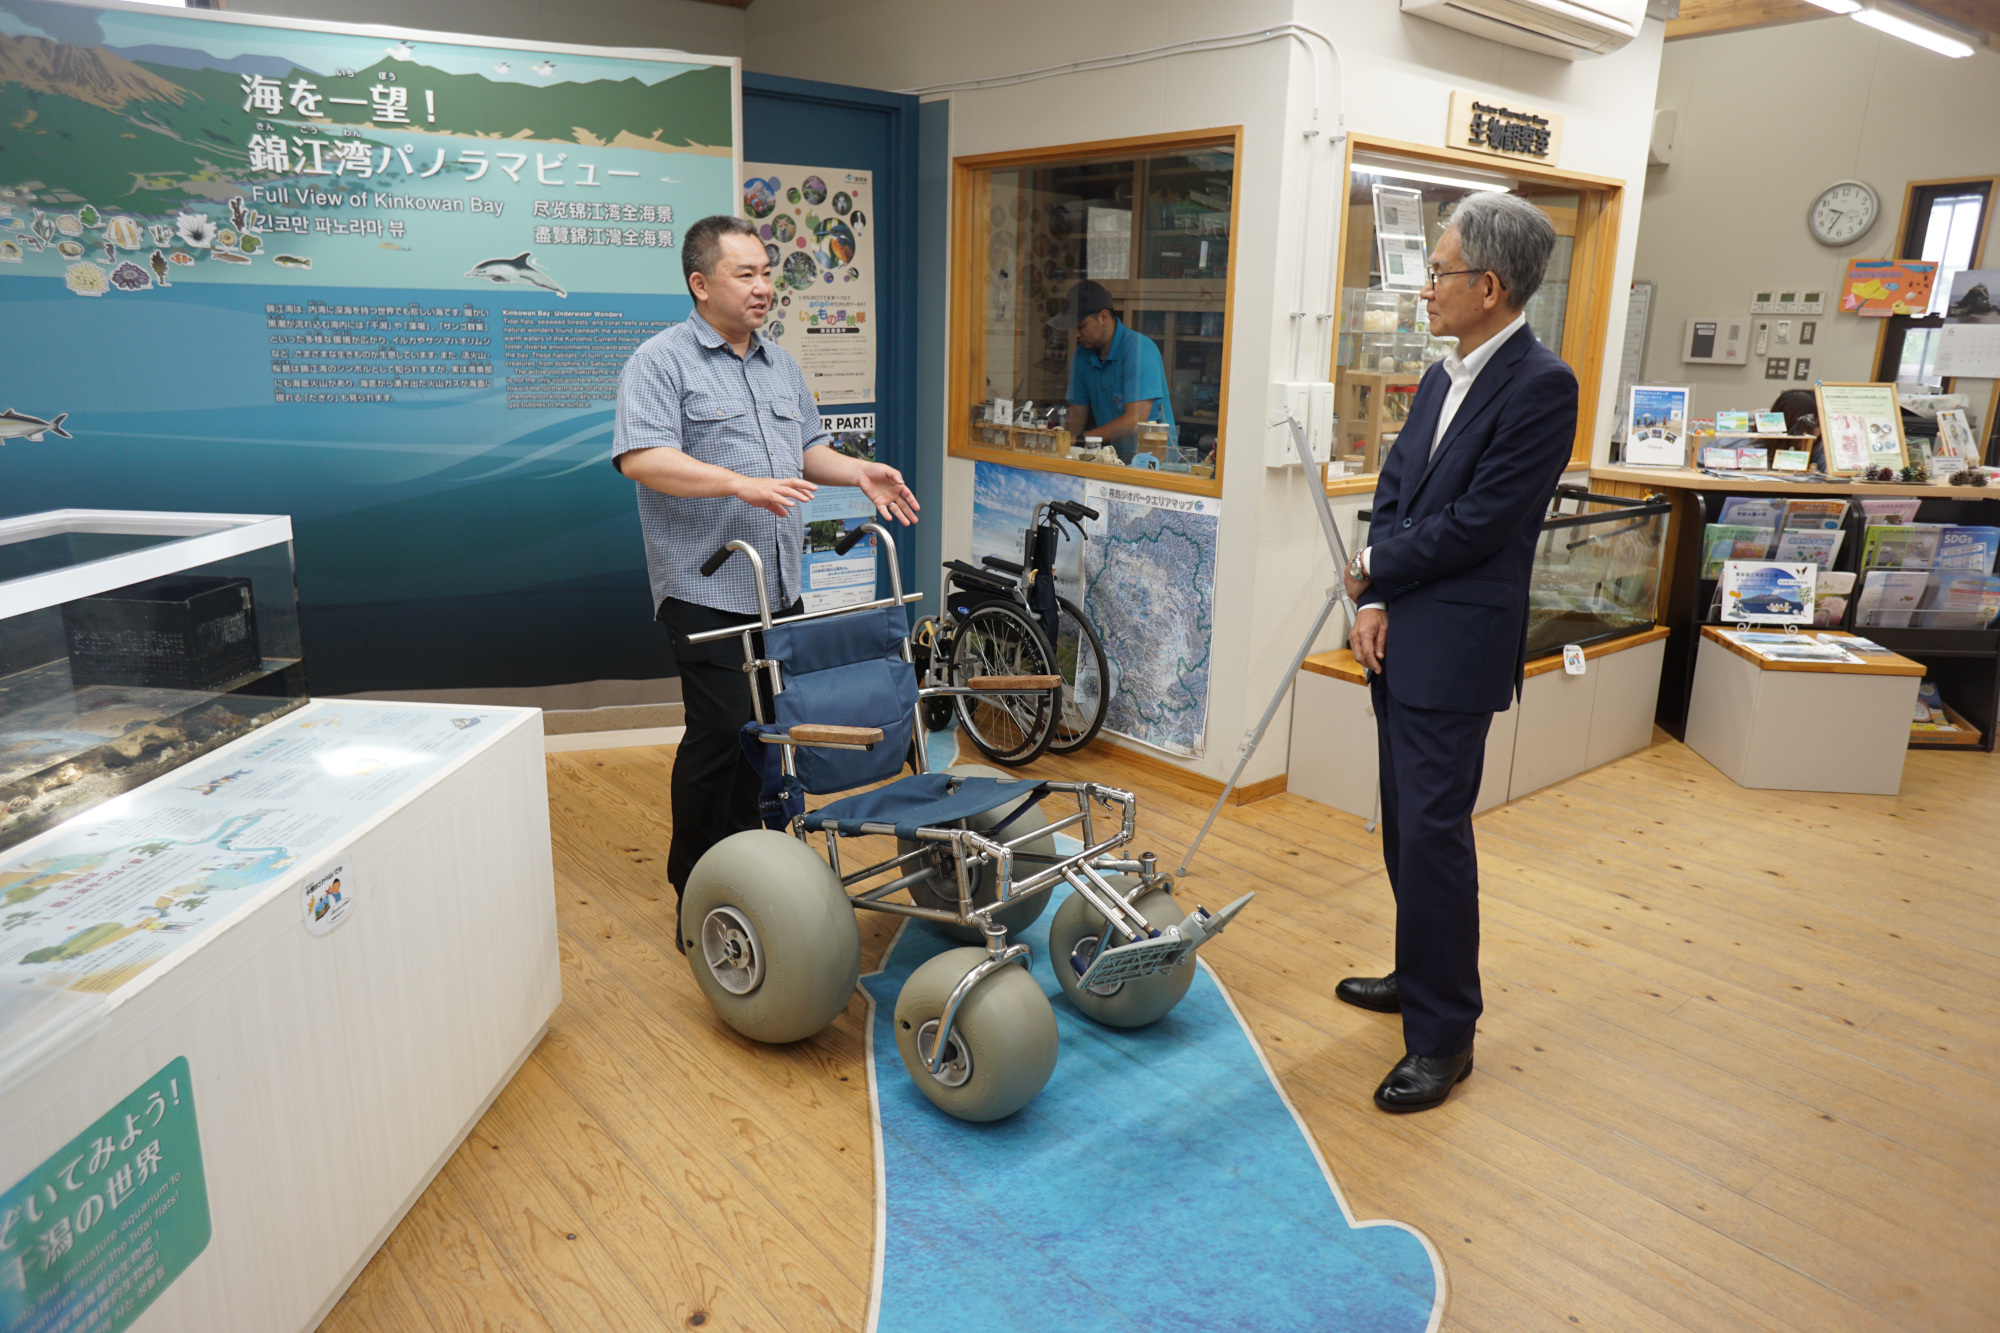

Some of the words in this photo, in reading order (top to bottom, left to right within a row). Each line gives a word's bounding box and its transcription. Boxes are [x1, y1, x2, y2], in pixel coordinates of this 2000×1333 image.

[335, 68, 356, 79] いち
[240, 73, 436, 124] 海を一望！
[1468, 113, 1552, 156] 生物観察室
[248, 134, 641, 187] 錦江湾パノラマビュー
[252, 186, 289, 204] Full
[296, 189, 343, 207] View
[349, 192, 368, 208] of
[374, 193, 464, 213] Kinkowan
[471, 197, 505, 217] Bay
[533, 200, 674, 224] 尽览锦江湾全海景
[255, 213, 310, 235] 긴코만
[315, 217, 383, 238] 파노라마
[388, 219, 406, 239] 뷰
[534, 226, 675, 249] 盡覽錦江灣全海景
[502, 309, 536, 317] Kinkowan
[554, 310, 593, 318] Underwater
[594, 311, 624, 319] Wonders
[836, 415, 873, 430] PART!
[1108, 487, 1195, 511] 霧島ジオパークエリアマップ
[1943, 534, 1974, 544] SDGs
[64, 1229, 118, 1284] miniature
[121, 1182, 170, 1232] aquarium
[171, 1171, 182, 1185] to
[80, 1259, 107, 1289] from
[109, 1241, 128, 1262] the
[130, 1215, 153, 1243] tidal
[155, 1189, 181, 1219] flats!
